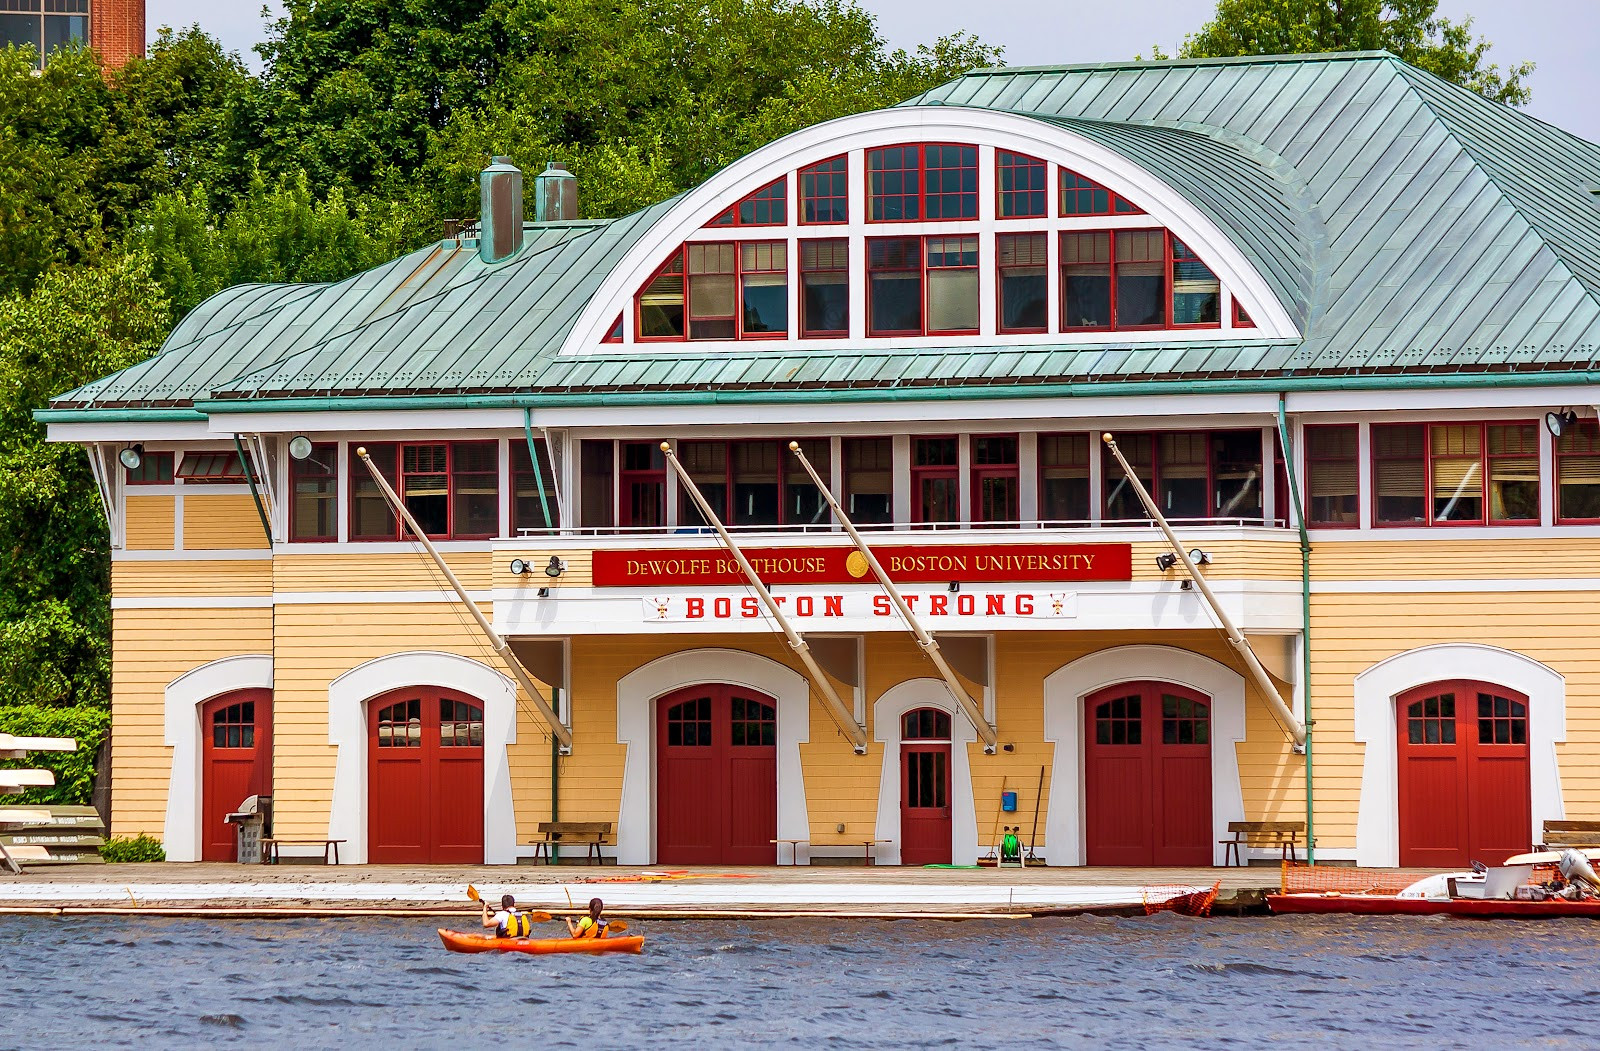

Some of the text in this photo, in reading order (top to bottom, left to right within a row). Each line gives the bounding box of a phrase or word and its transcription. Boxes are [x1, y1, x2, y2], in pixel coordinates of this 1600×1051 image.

[716, 557, 826, 574] BOTHOUSE
[890, 554, 1096, 572] BOSTON UNIVERSITY
[873, 594, 1034, 616] STRONG
